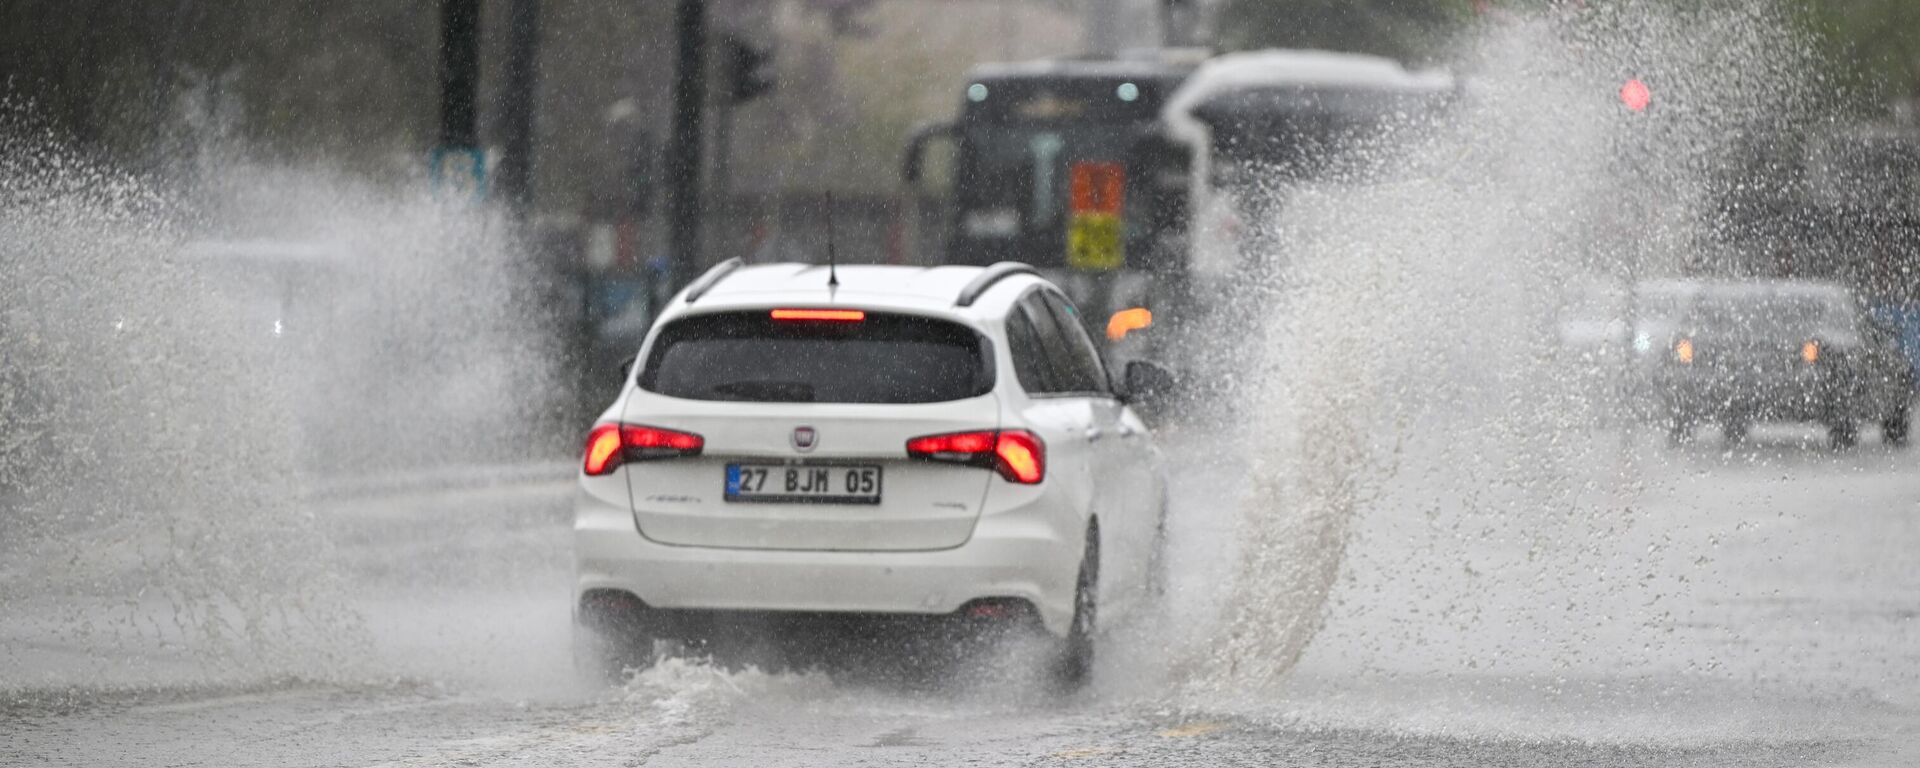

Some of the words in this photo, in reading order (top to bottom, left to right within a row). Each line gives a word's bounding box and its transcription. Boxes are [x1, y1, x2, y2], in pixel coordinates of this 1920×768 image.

[740, 469, 768, 491] 27
[785, 468, 829, 492] BJM
[846, 469, 874, 493] 05
